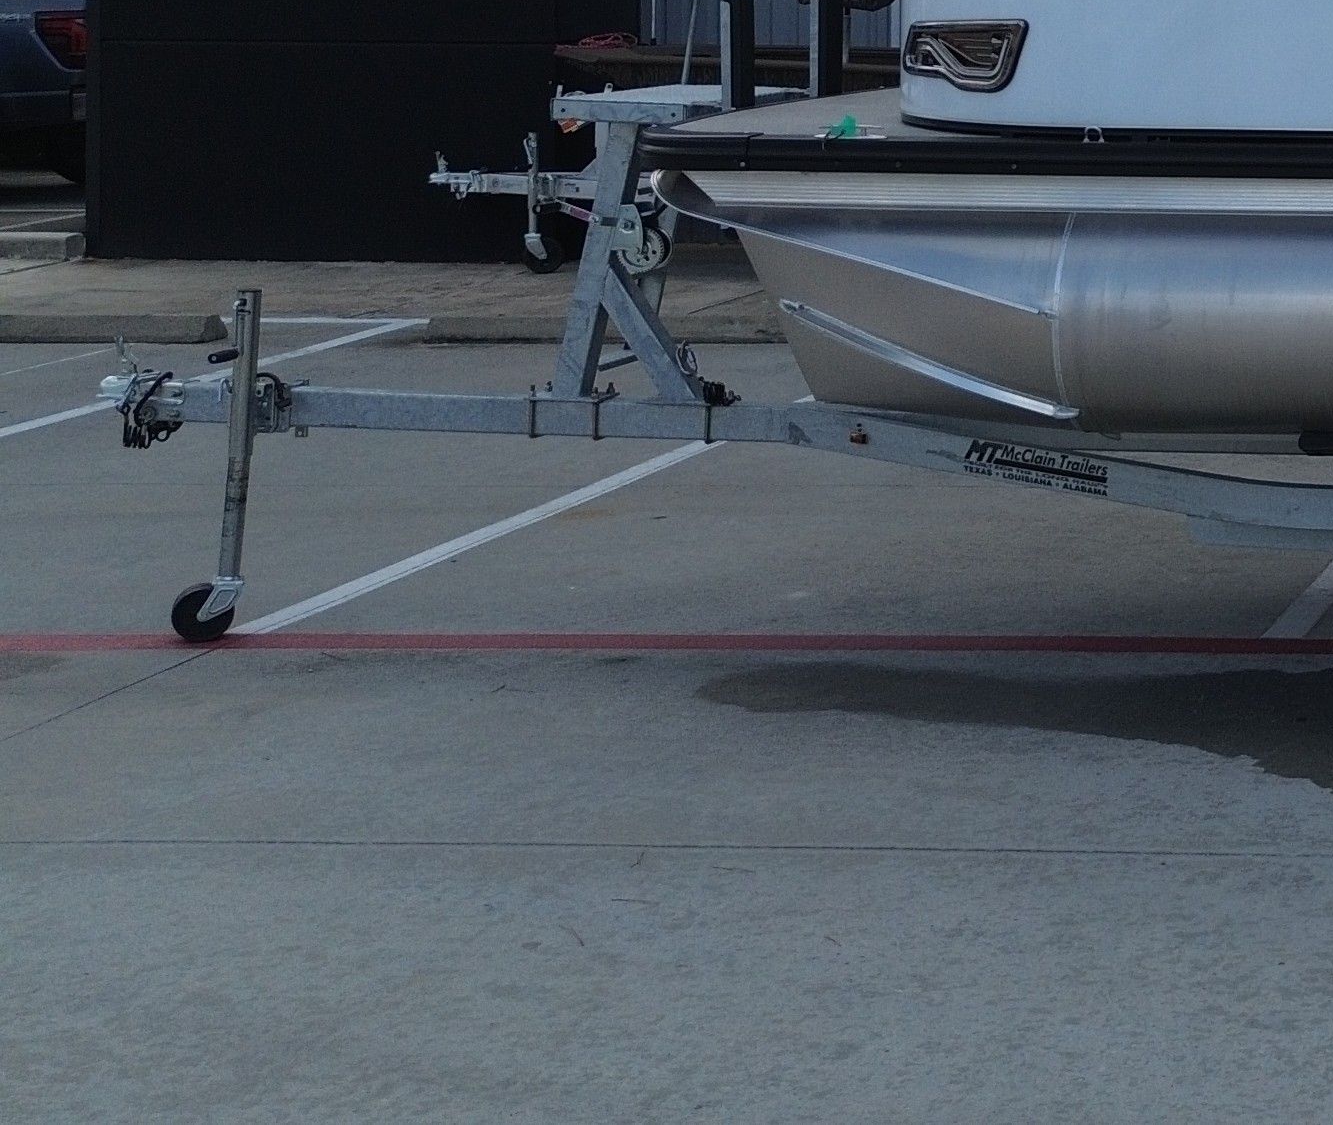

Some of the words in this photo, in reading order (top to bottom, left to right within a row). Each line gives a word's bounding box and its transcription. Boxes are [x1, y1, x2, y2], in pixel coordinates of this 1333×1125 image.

[1001, 444, 1056, 467] McClain
[1059, 454, 1109, 476] Trailers
[963, 465, 993, 477] TEXAS
[1002, 472, 1052, 487] LOUISIANA
[1062, 482, 1108, 496] ALABAMA
